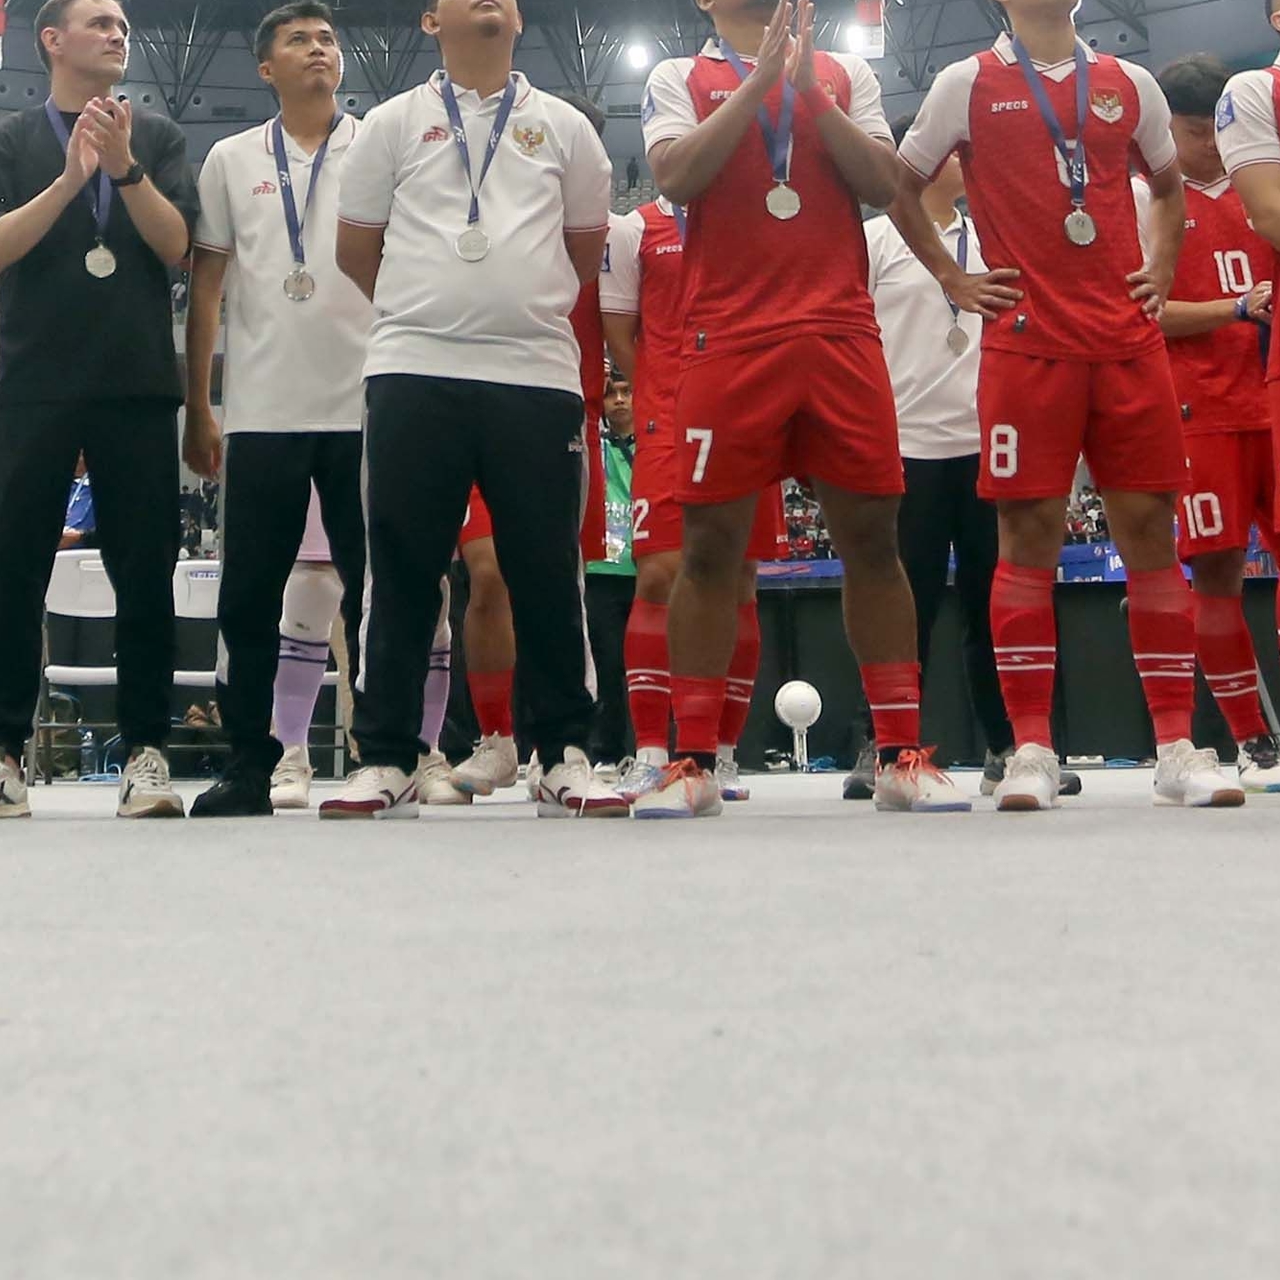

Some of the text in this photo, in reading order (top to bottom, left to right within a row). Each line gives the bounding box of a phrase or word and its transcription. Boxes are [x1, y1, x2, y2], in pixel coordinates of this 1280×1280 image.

[709, 90, 734, 100] SPE
[991, 100, 1029, 113] SPECS
[1213, 250, 1254, 294] 10
[685, 427, 713, 483] 7
[990, 424, 1018, 478] 8
[1183, 492, 1224, 539] 10
